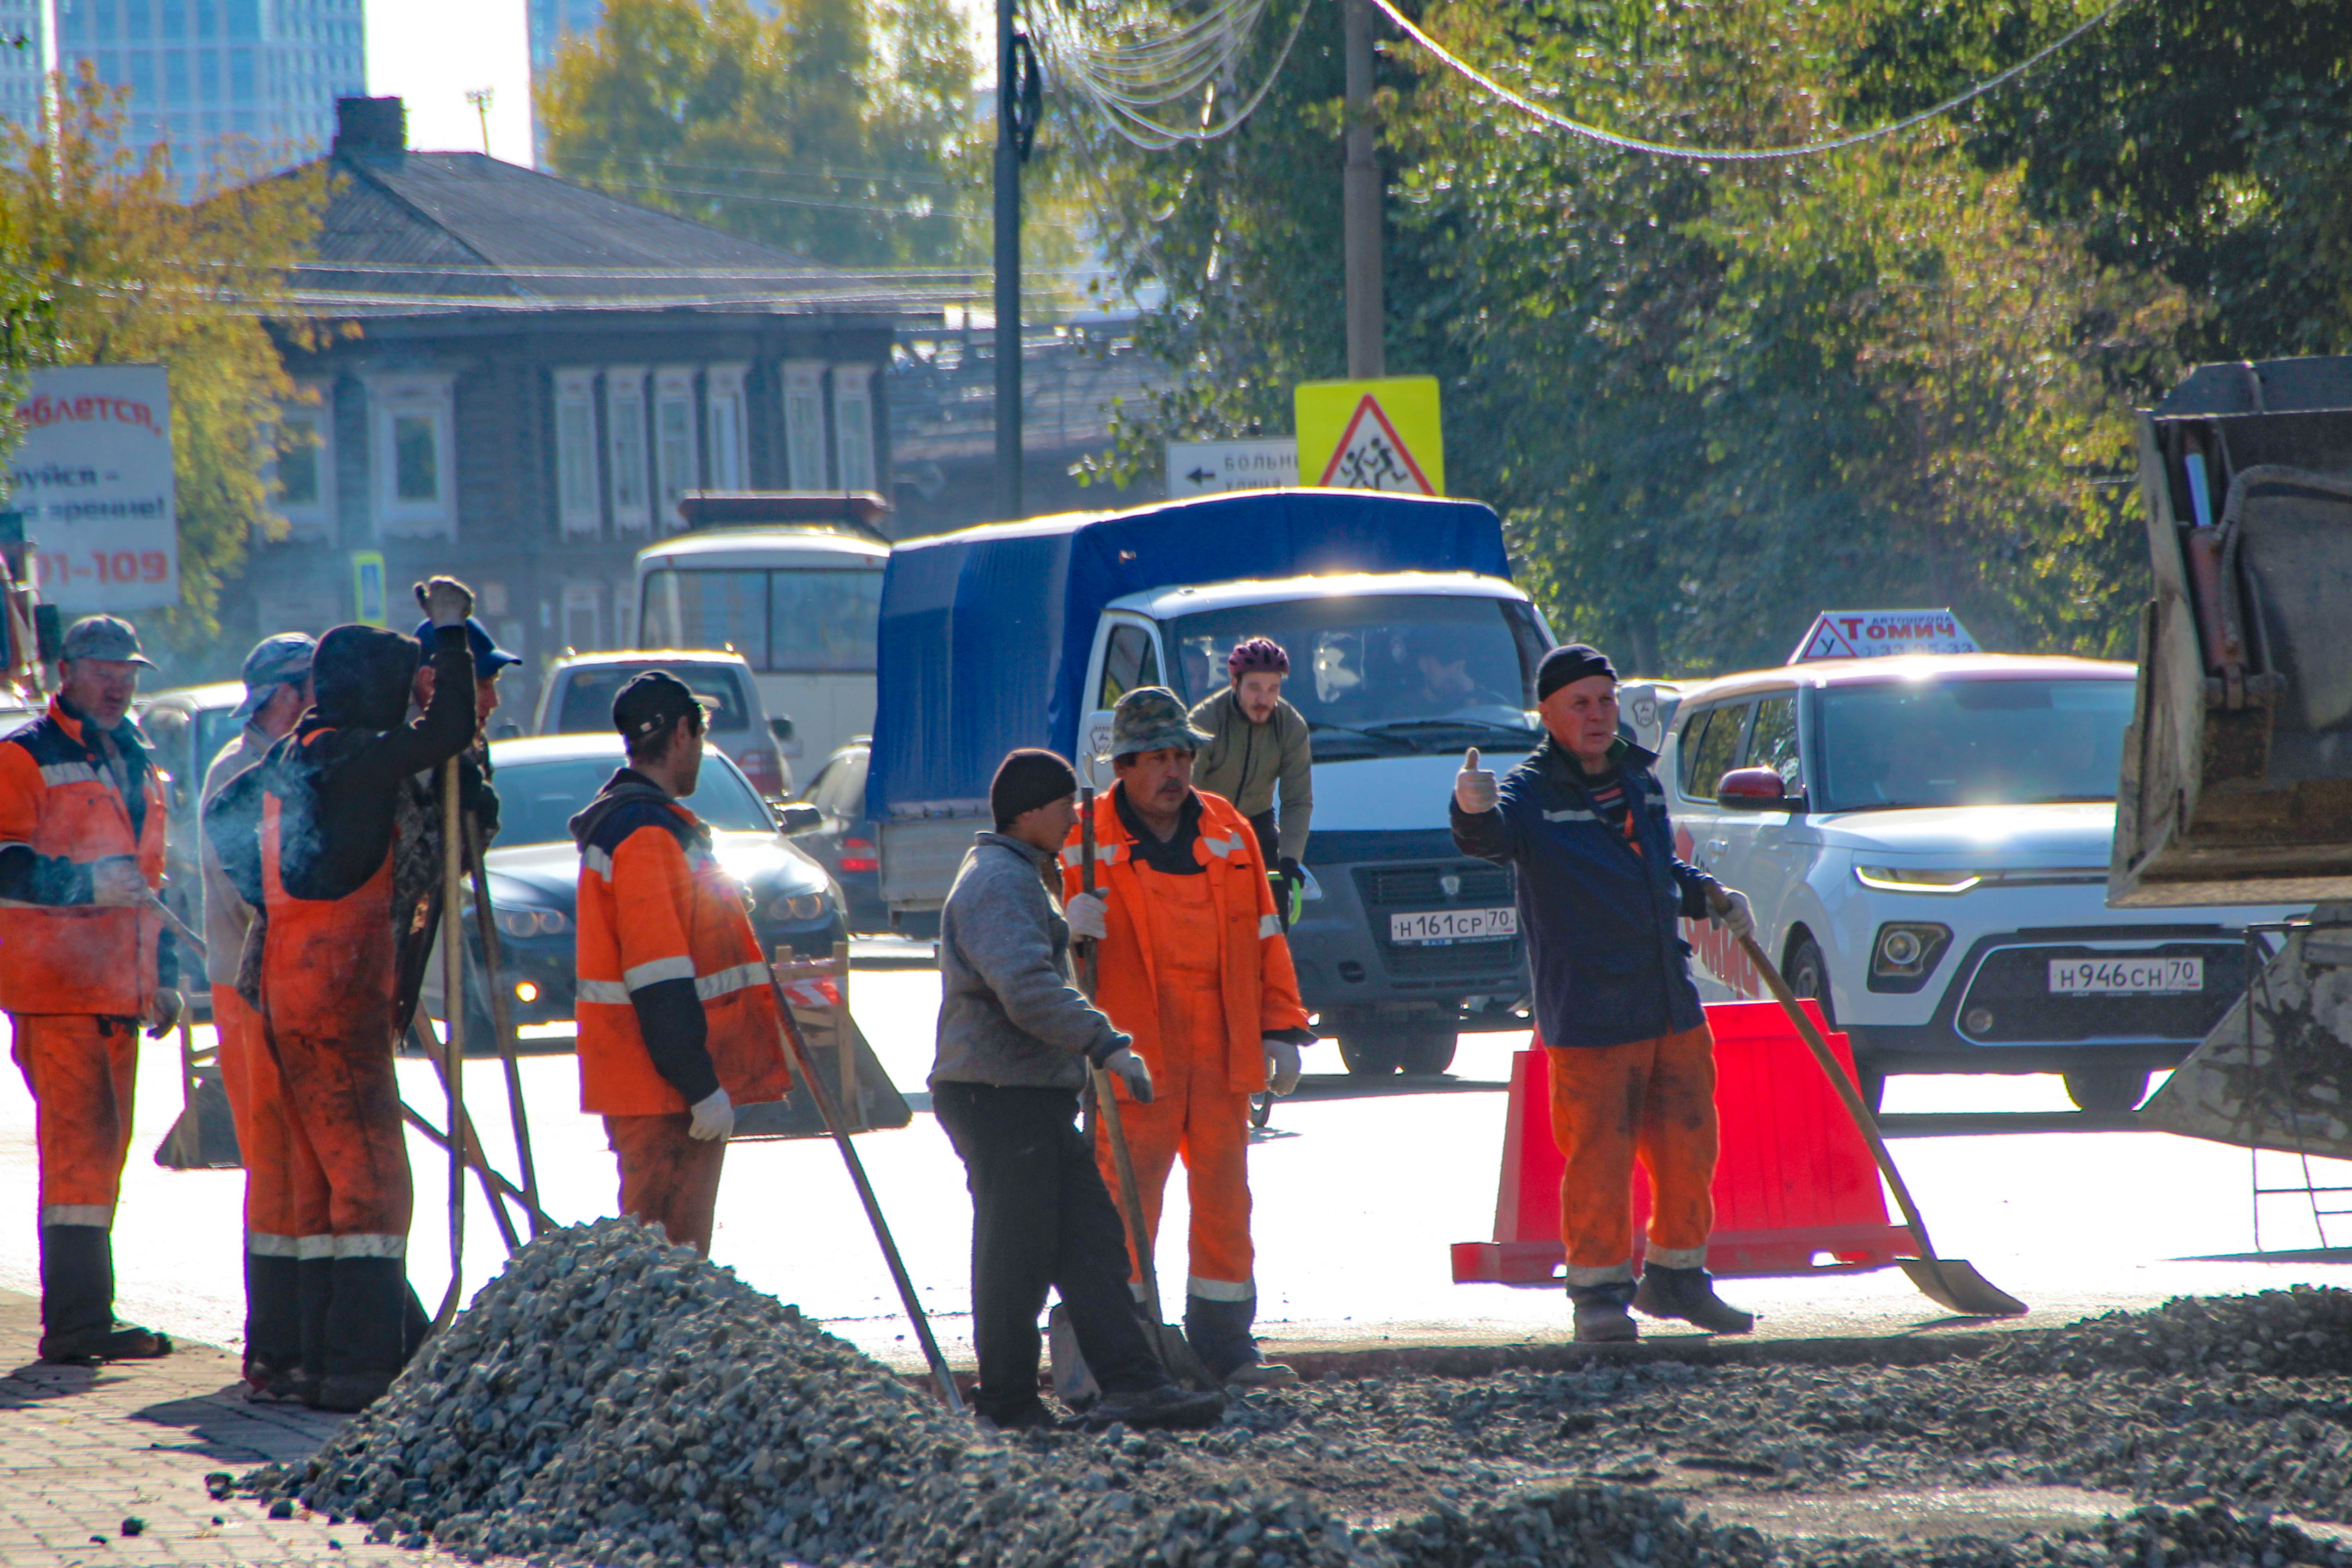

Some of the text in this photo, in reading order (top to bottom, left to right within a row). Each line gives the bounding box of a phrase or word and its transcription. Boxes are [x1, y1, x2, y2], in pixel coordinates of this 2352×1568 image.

[1839, 618, 1955, 640] Томич
[1400, 910, 1509, 937] Н161СР 70
[2061, 961, 2193, 988] Н946СН 70
